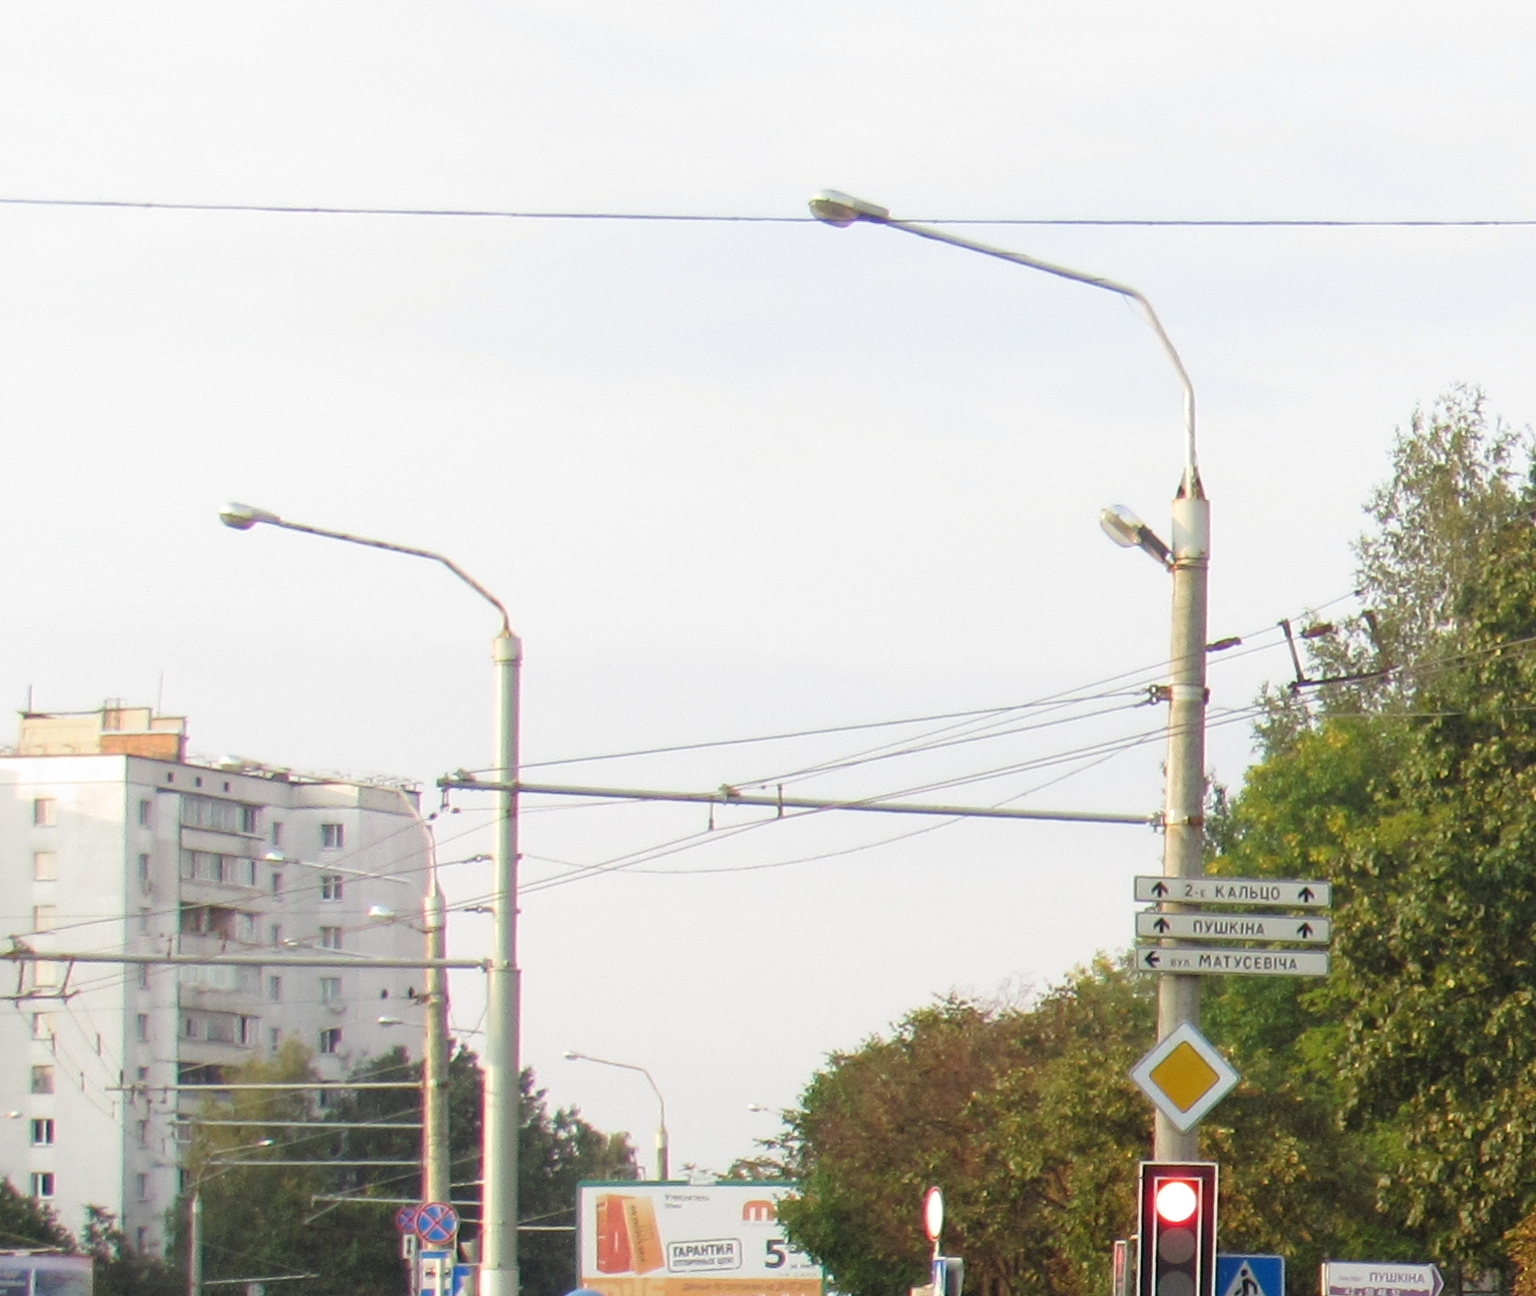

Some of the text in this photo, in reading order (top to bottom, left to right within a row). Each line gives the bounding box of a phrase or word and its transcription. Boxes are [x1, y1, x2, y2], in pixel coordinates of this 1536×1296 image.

[1215, 885, 1281, 901] КАЛЬЦО
[1192, 919, 1266, 936] ПУШКІНА
[1198, 954, 1298, 971] МАТУСЕВІЧА
[672, 1243, 734, 1259] ГАРАНТИЯ
[1369, 1271, 1426, 1284] ПУШКІНА
